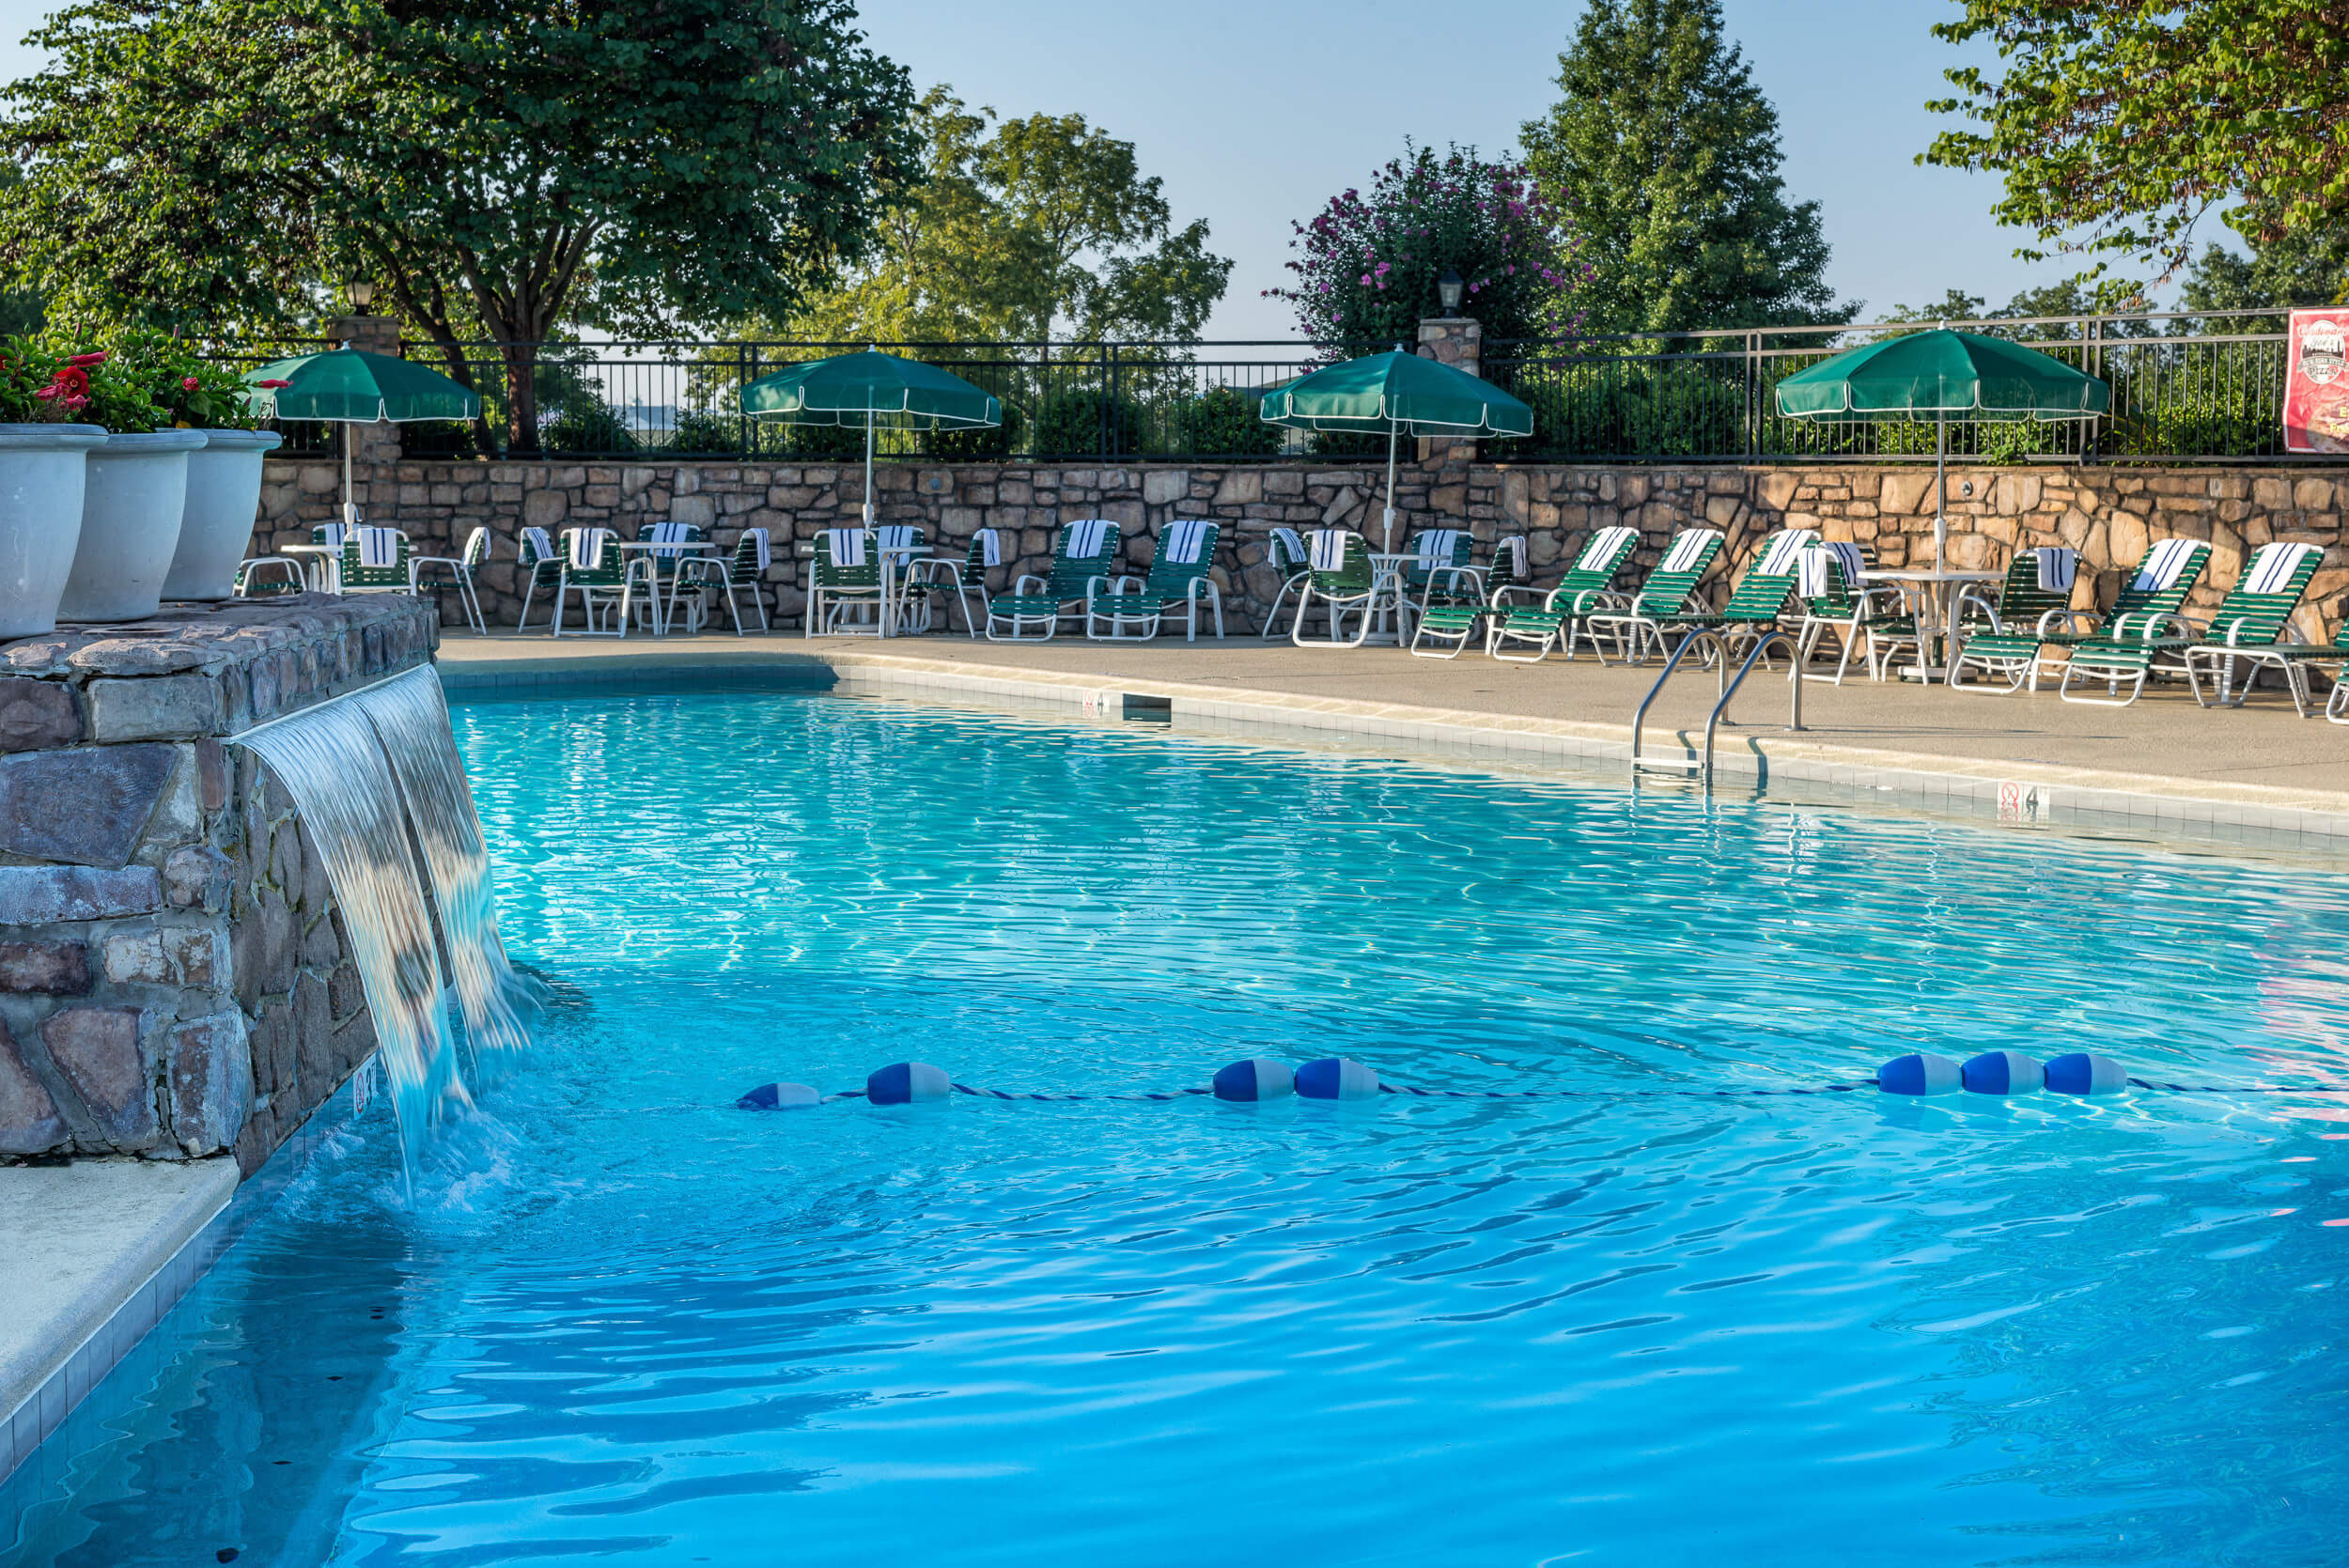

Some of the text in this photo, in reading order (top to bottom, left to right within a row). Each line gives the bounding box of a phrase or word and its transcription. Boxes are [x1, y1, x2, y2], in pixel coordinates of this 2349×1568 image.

[2309, 367, 2338, 376] PIZZA
[2026, 786, 2039, 807] 4
[366, 1067, 372, 1105] 3
